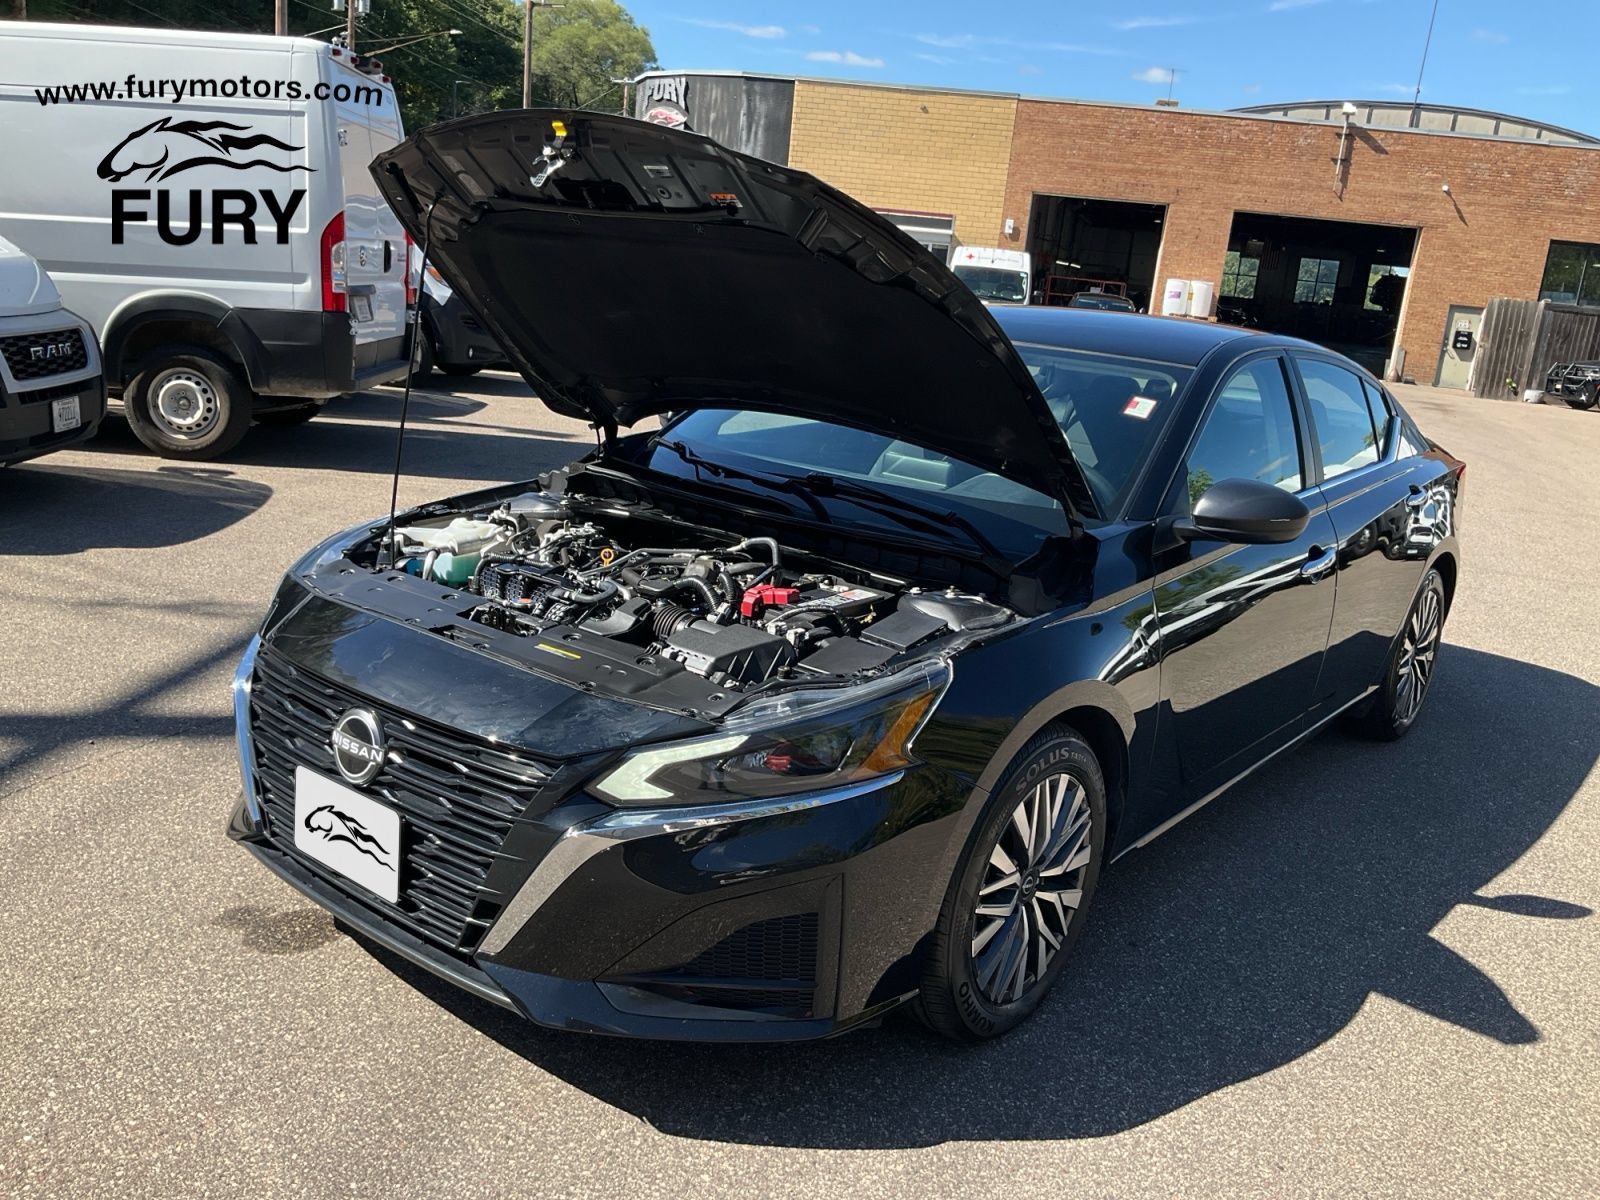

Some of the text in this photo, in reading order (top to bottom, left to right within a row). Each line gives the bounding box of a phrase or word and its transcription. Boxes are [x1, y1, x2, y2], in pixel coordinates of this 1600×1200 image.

[34, 74, 384, 107] www.furymotors.com
[642, 77, 686, 110] FURY
[111, 189, 308, 246] FURY
[30, 343, 72, 360] RAM
[332, 730, 383, 762] NISSAN
[1015, 747, 1069, 796] SOLUS
